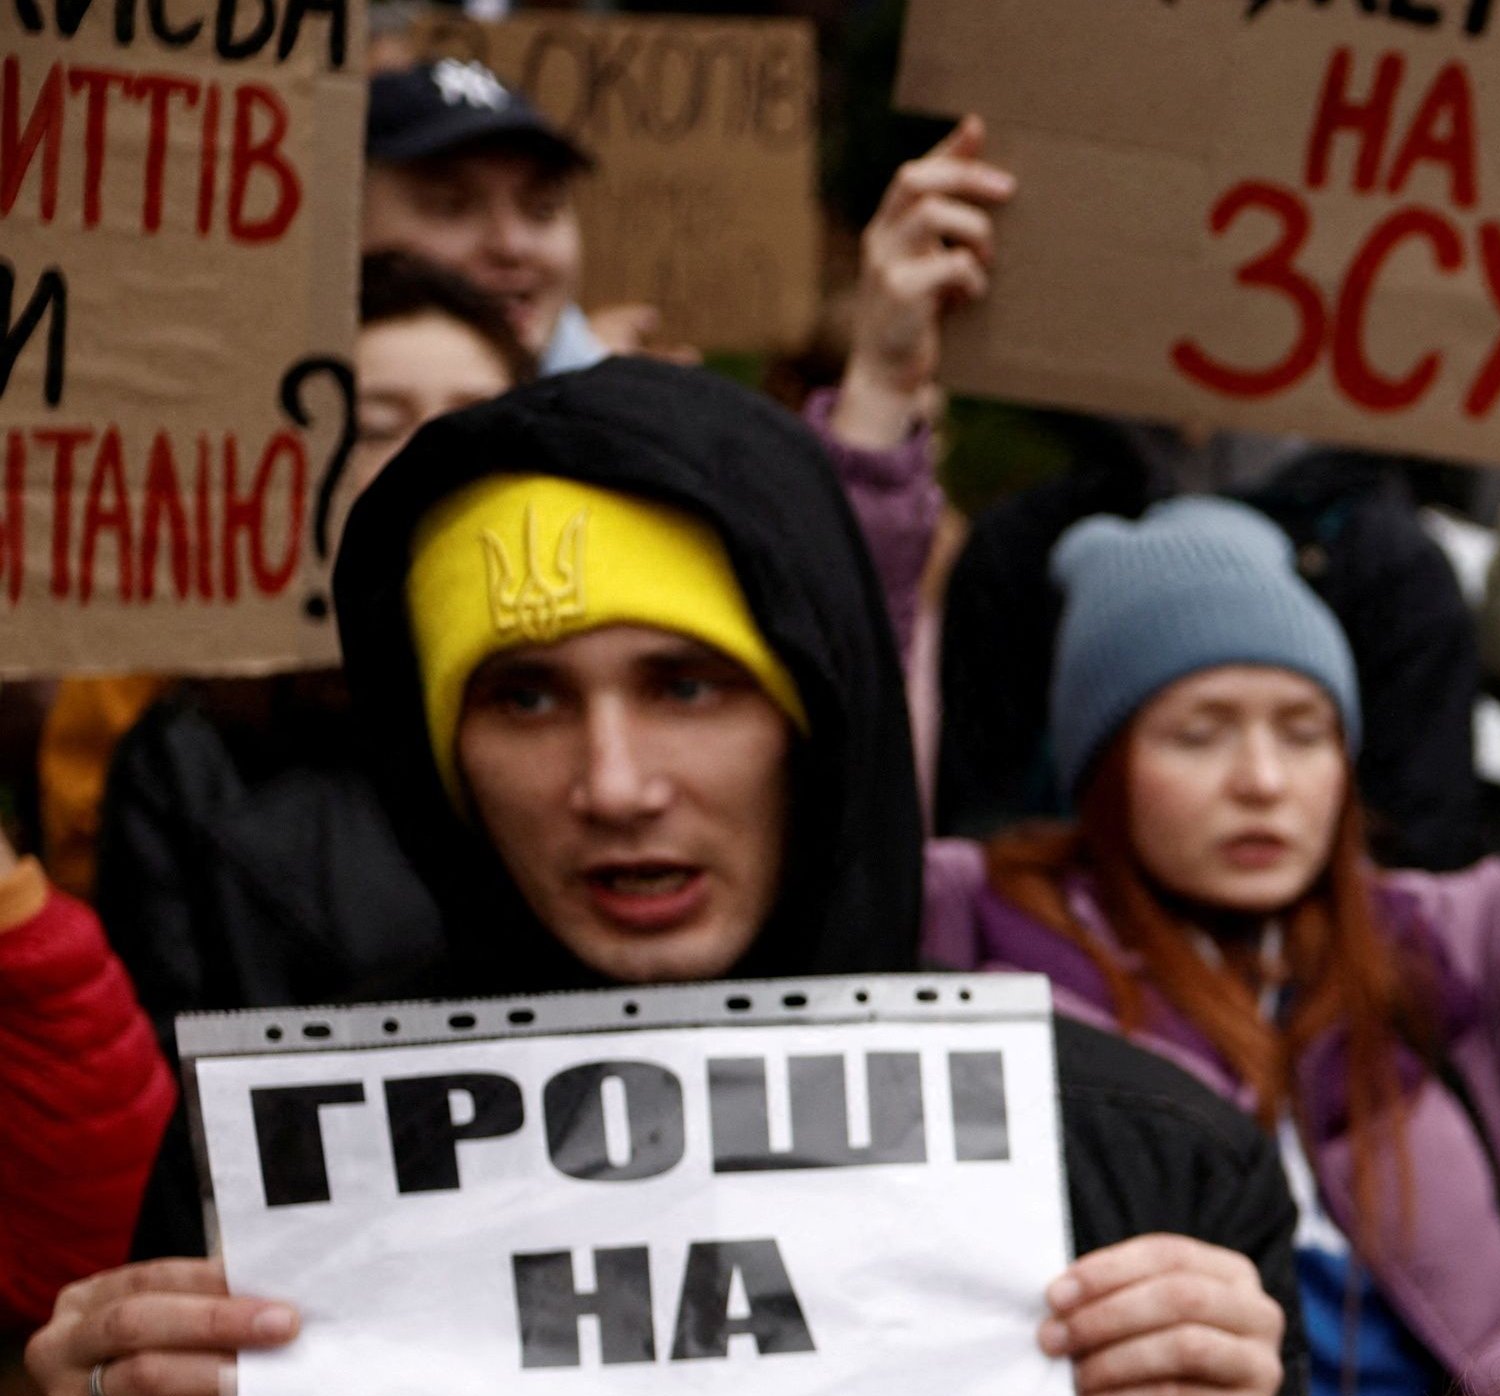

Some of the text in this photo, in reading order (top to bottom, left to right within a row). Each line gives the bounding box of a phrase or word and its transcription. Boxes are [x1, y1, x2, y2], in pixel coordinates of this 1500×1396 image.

[1304, 45, 1477, 211] НА
[250, 1050, 1010, 1206] ГРОШІ
[511, 1237, 816, 1369] НА
